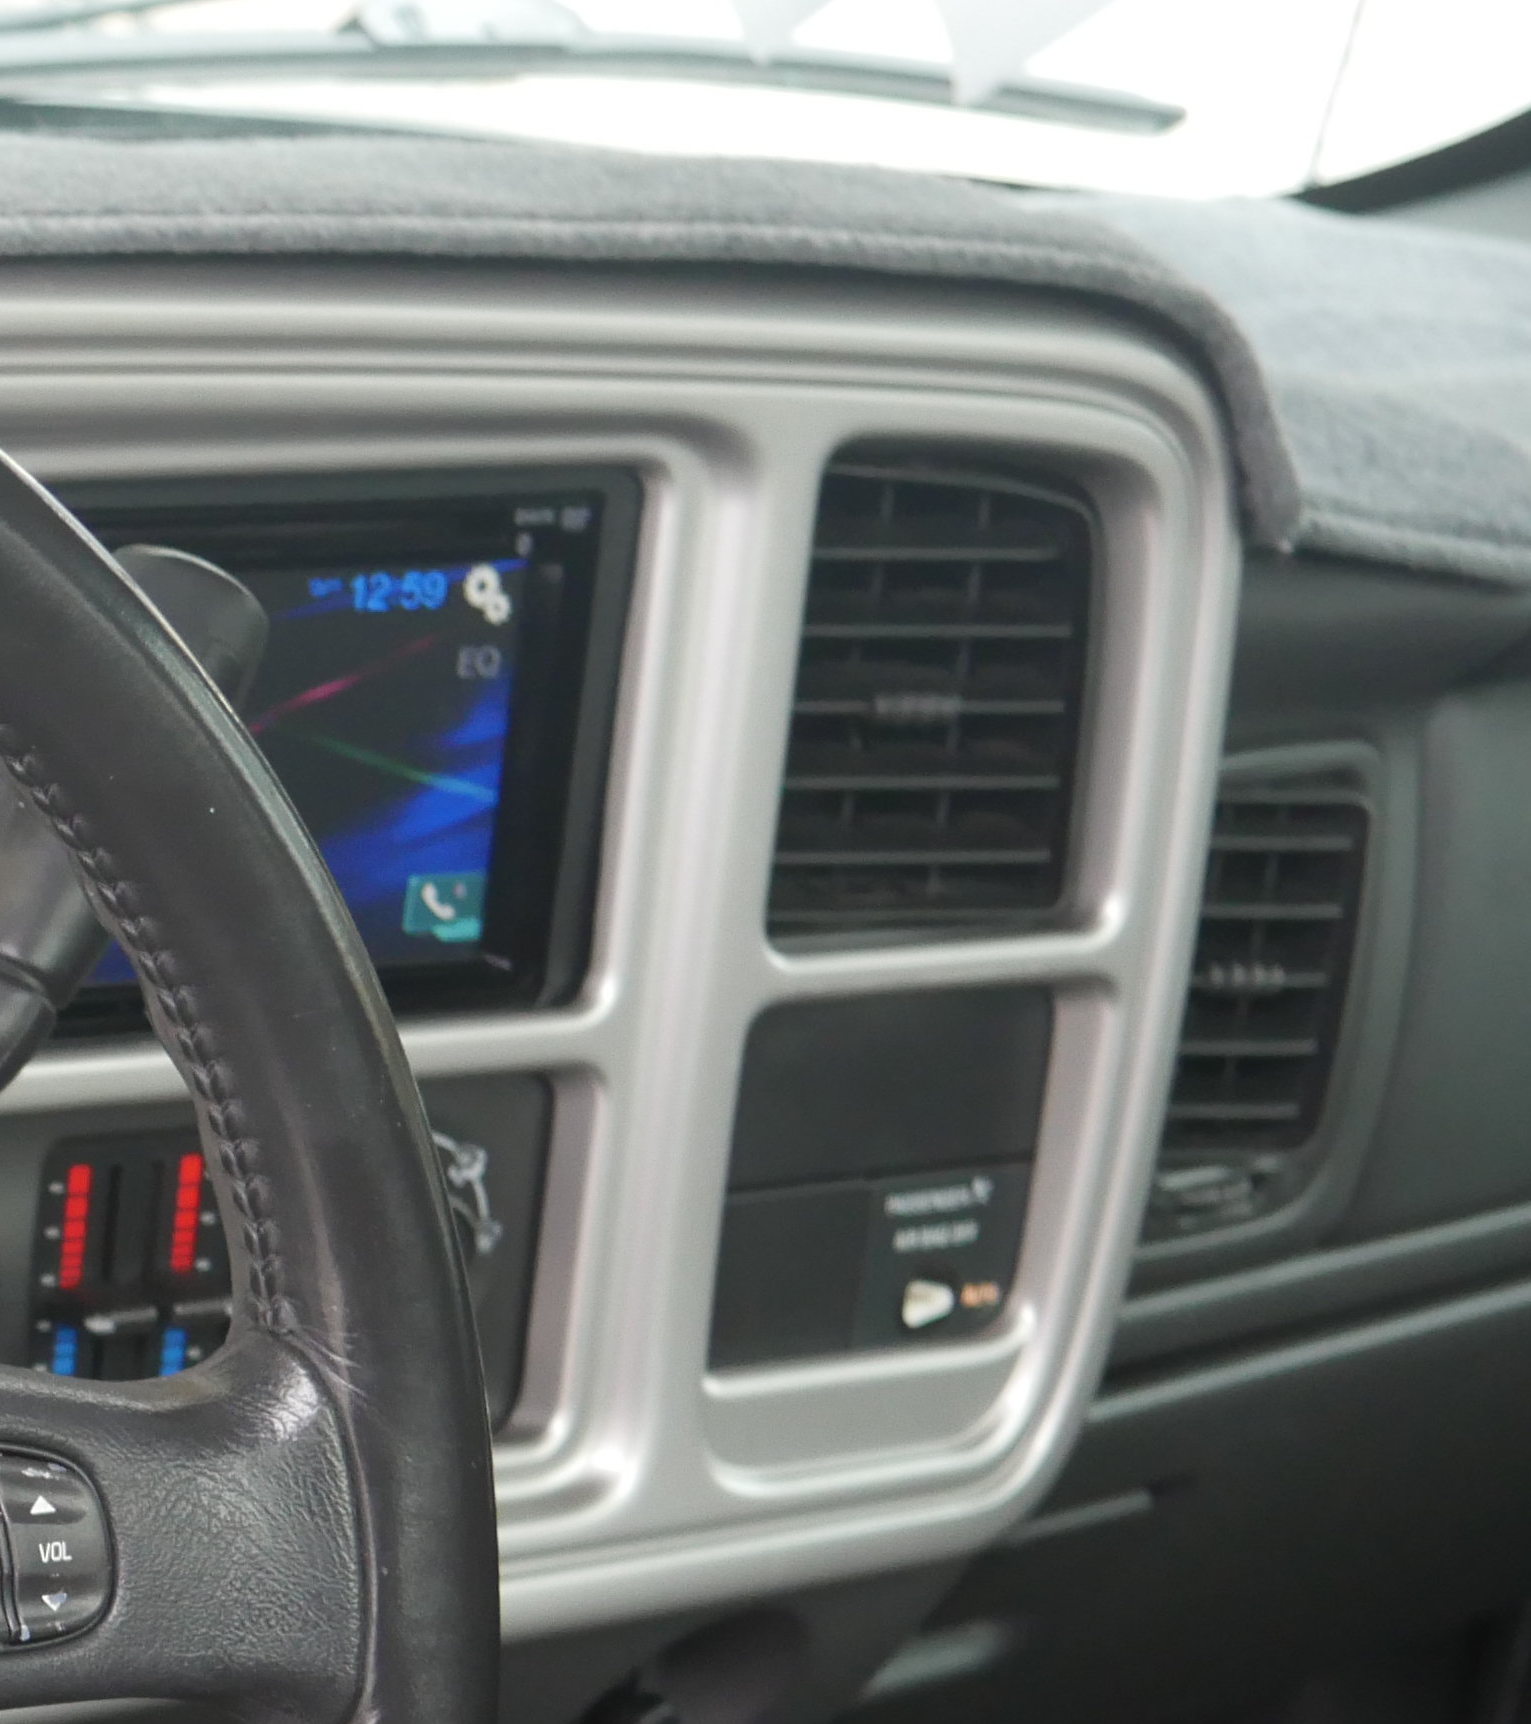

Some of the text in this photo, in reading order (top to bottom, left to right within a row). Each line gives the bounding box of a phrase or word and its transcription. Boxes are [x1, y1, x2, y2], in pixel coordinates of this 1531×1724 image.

[350, 571, 448, 612] 12:59
[456, 646, 503, 680] EQ
[38, 1540, 73, 1563] VOL
